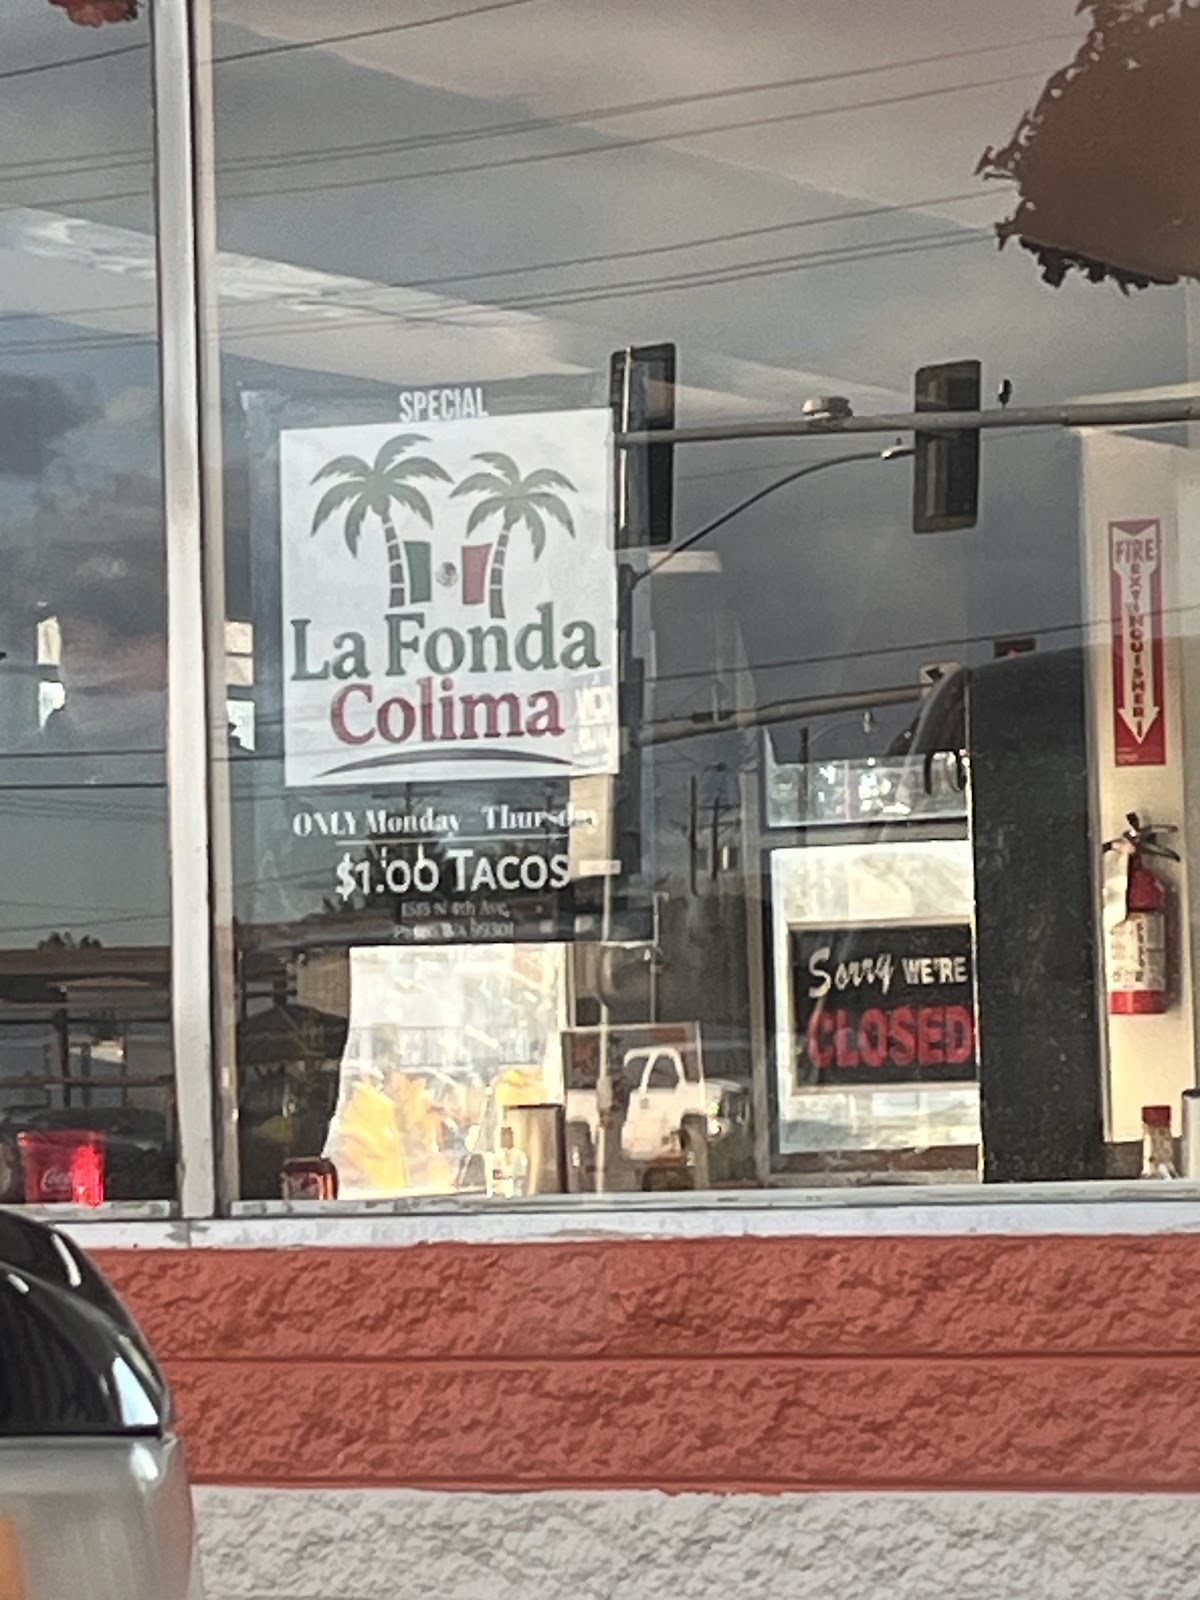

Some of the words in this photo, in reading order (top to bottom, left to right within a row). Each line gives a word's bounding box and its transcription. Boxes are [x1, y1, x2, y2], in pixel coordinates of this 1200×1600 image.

[399, 387, 490, 423] SPECIAL
[1114, 538, 1154, 562] FIRE
[290, 617, 371, 681] La
[385, 601, 602, 677] Fonda
[330, 676, 566, 745] Colima
[293, 810, 357, 837] ONLY
[365, 806, 461, 834] Monday
[335, 852, 440, 902] $1.00
[445, 848, 572, 892] TACOS
[808, 946, 895, 998] Sorry
[902, 955, 969, 985] WE'RE
[807, 1004, 973, 1069] CLOSED
